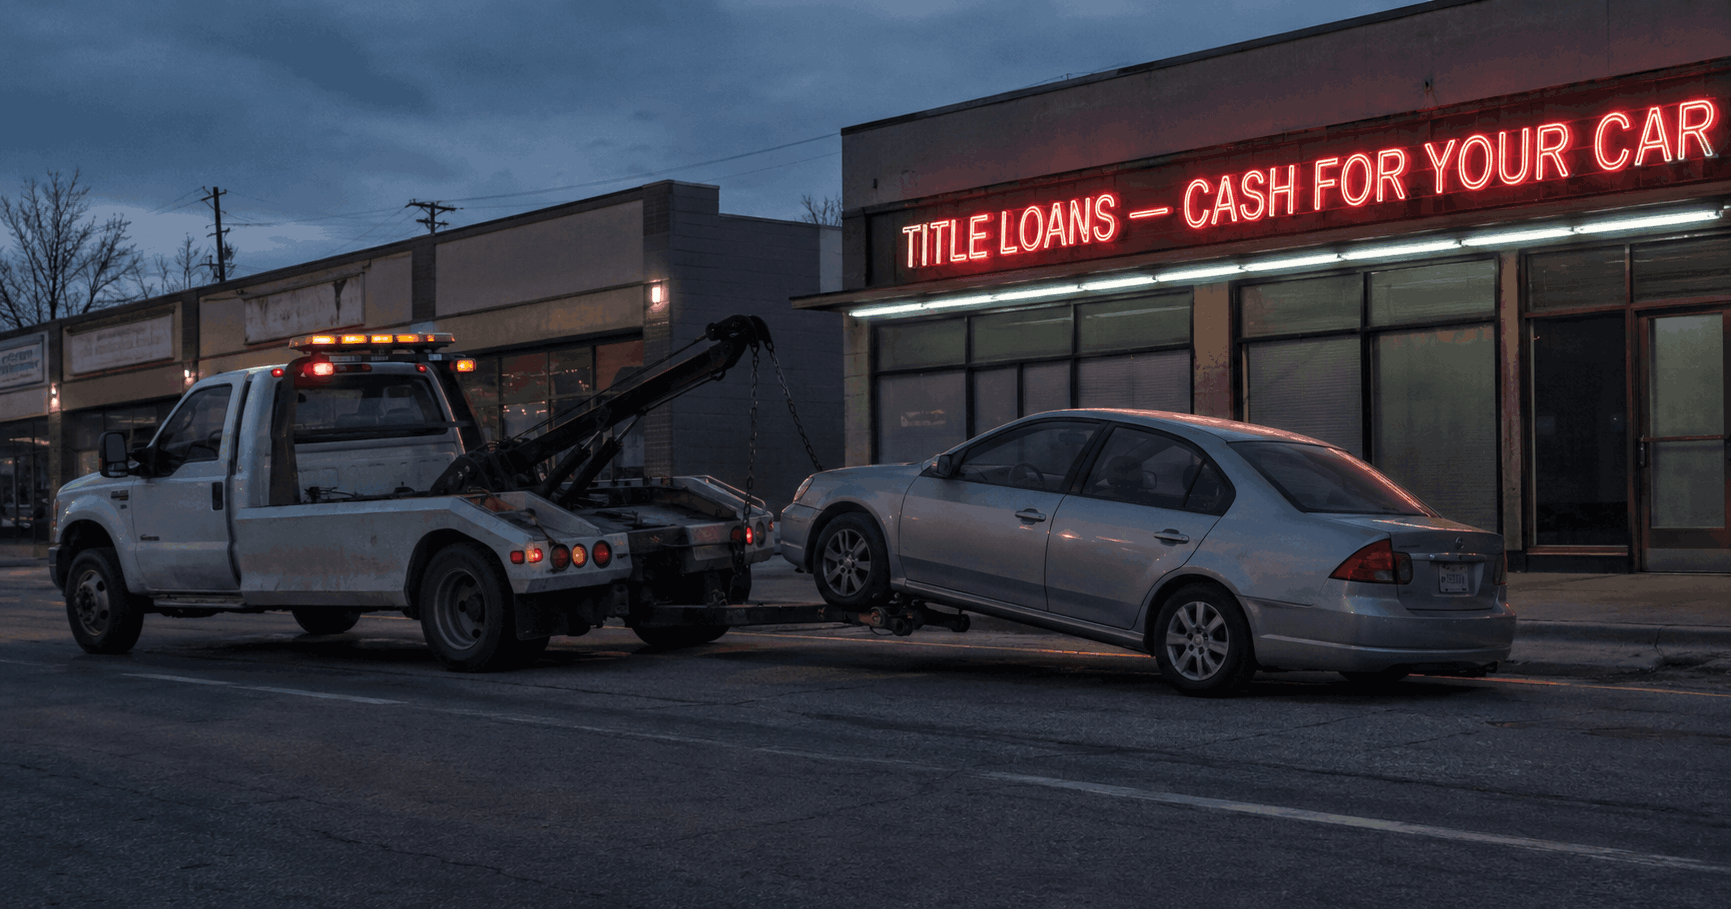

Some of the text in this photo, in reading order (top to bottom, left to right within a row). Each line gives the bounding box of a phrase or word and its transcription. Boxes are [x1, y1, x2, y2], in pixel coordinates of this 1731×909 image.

[902, 213, 990, 268] TITLE
[1000, 194, 1116, 255] LOANS
[1184, 165, 1295, 229] CASH
[1314, 148, 1406, 211] FOR
[1424, 123, 1569, 194] YOUR
[1594, 100, 1715, 171] CAR
